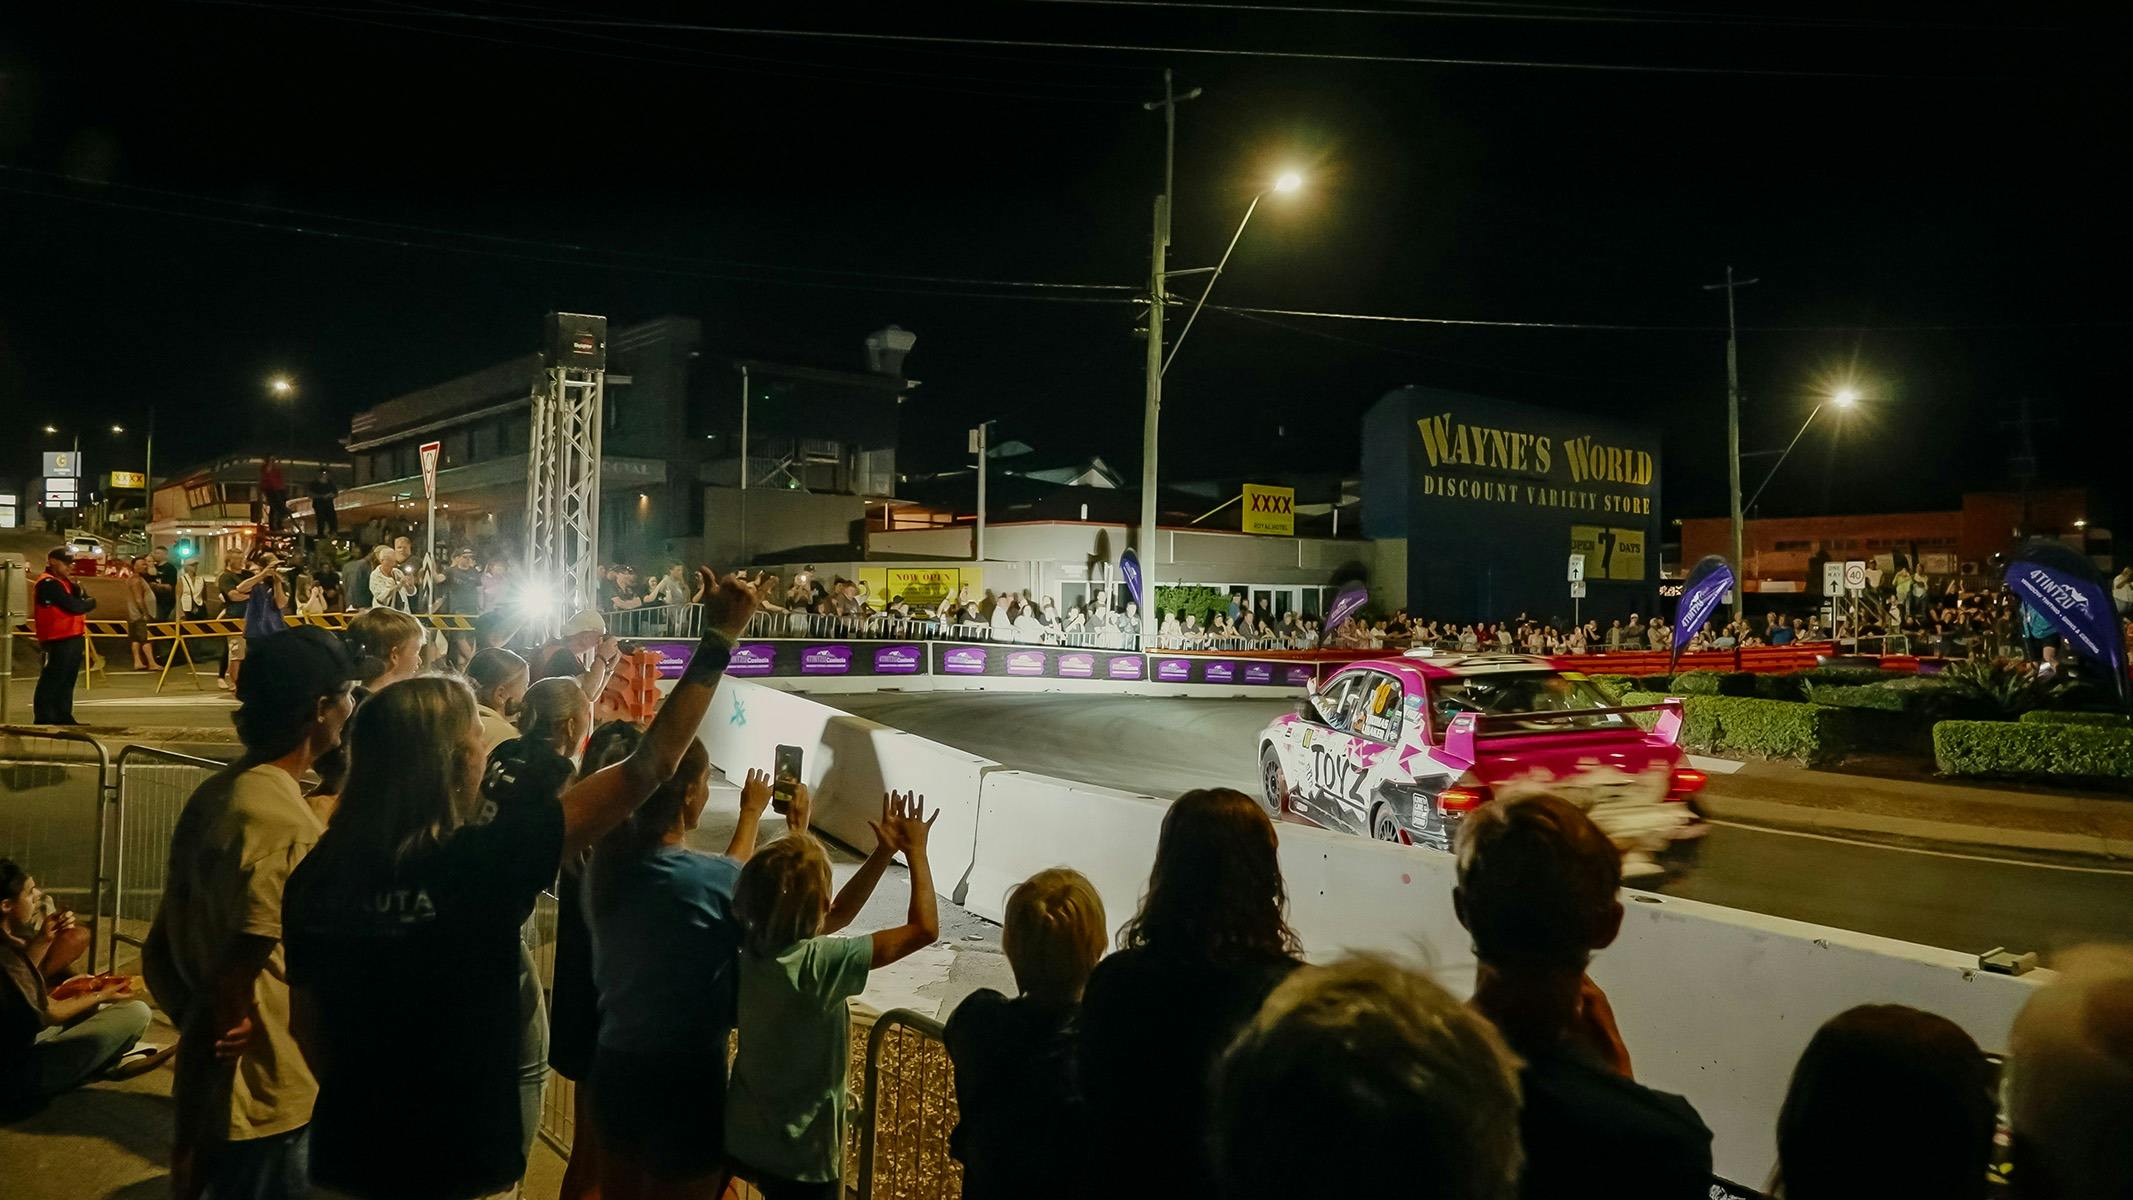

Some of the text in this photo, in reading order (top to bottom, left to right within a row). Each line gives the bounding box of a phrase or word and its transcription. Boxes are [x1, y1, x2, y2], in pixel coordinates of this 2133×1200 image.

[1416, 412, 1653, 485] WAYNE'S WORLD
[1251, 493, 1291, 514] XXXX
[1423, 475, 1650, 515] DISCOUNT VARIETY STORE
[1598, 532, 1616, 568] 7
[1619, 543, 1641, 553] DAYS
[896, 573, 952, 581] NOW OPEN
[1850, 570, 1861, 580] 40
[2030, 569, 2076, 609] 4TINT2U
[1311, 744, 1369, 805] TOYZ
